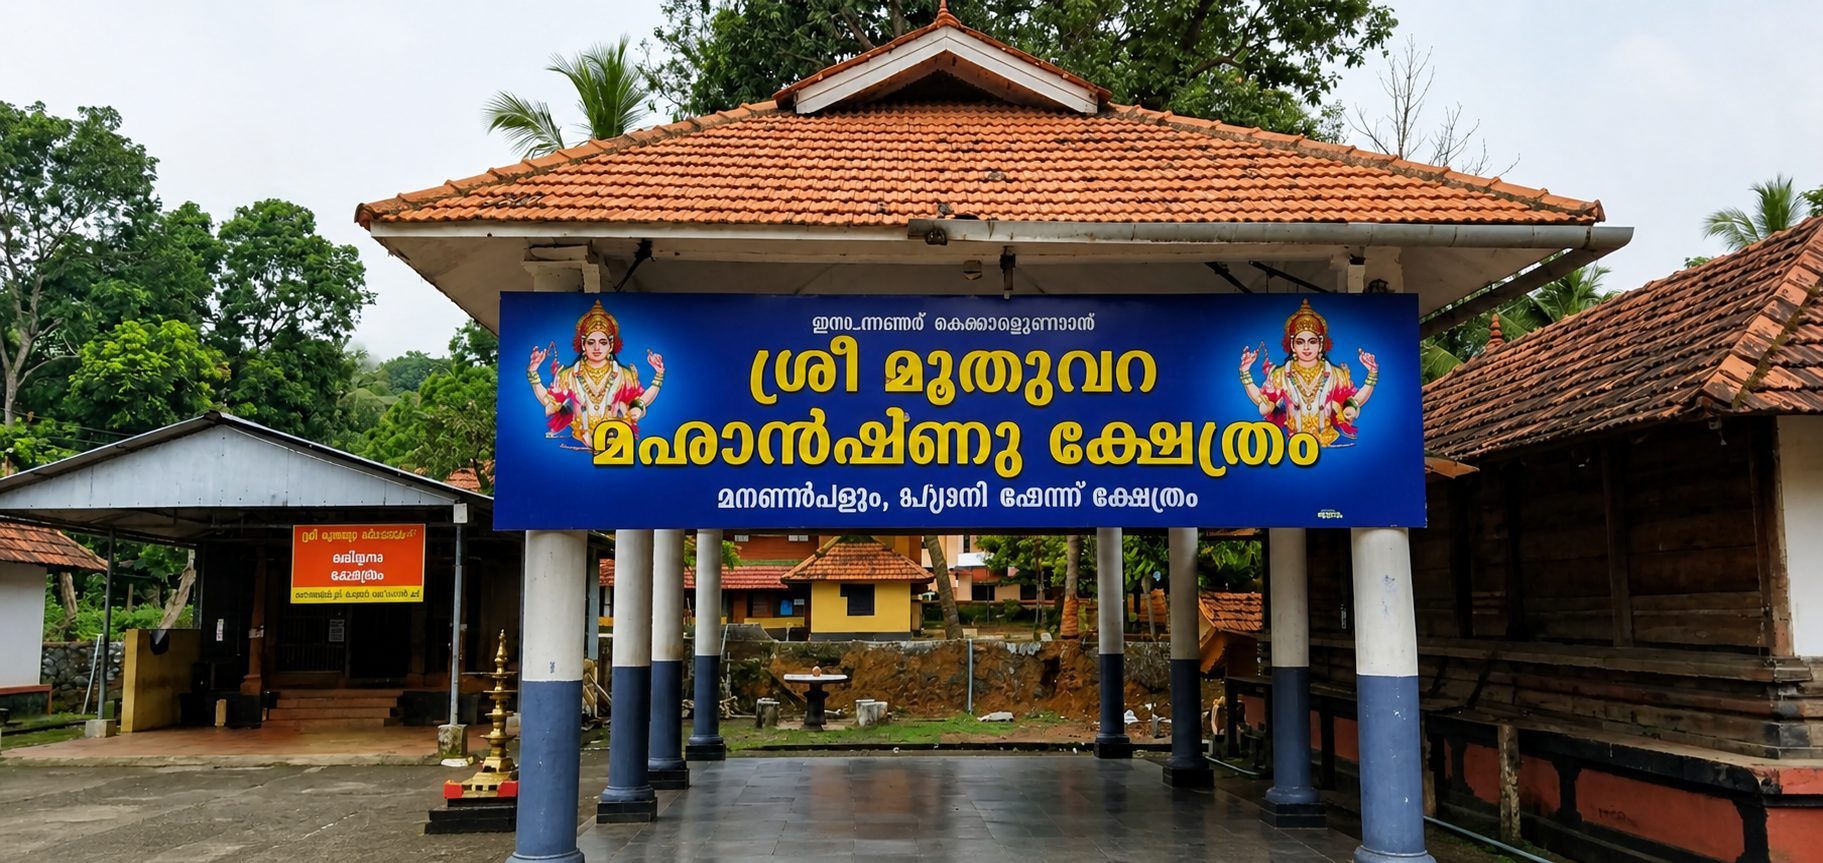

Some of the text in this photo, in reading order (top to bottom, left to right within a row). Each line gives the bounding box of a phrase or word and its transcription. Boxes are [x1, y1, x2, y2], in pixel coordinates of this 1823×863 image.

[750, 335, 1157, 406] ശ്രീ മൂതുവറ
[1049, 421, 1320, 477] ക്ഷേത്രം
[1092, 485, 1199, 514] ക്ഷേത്രം
